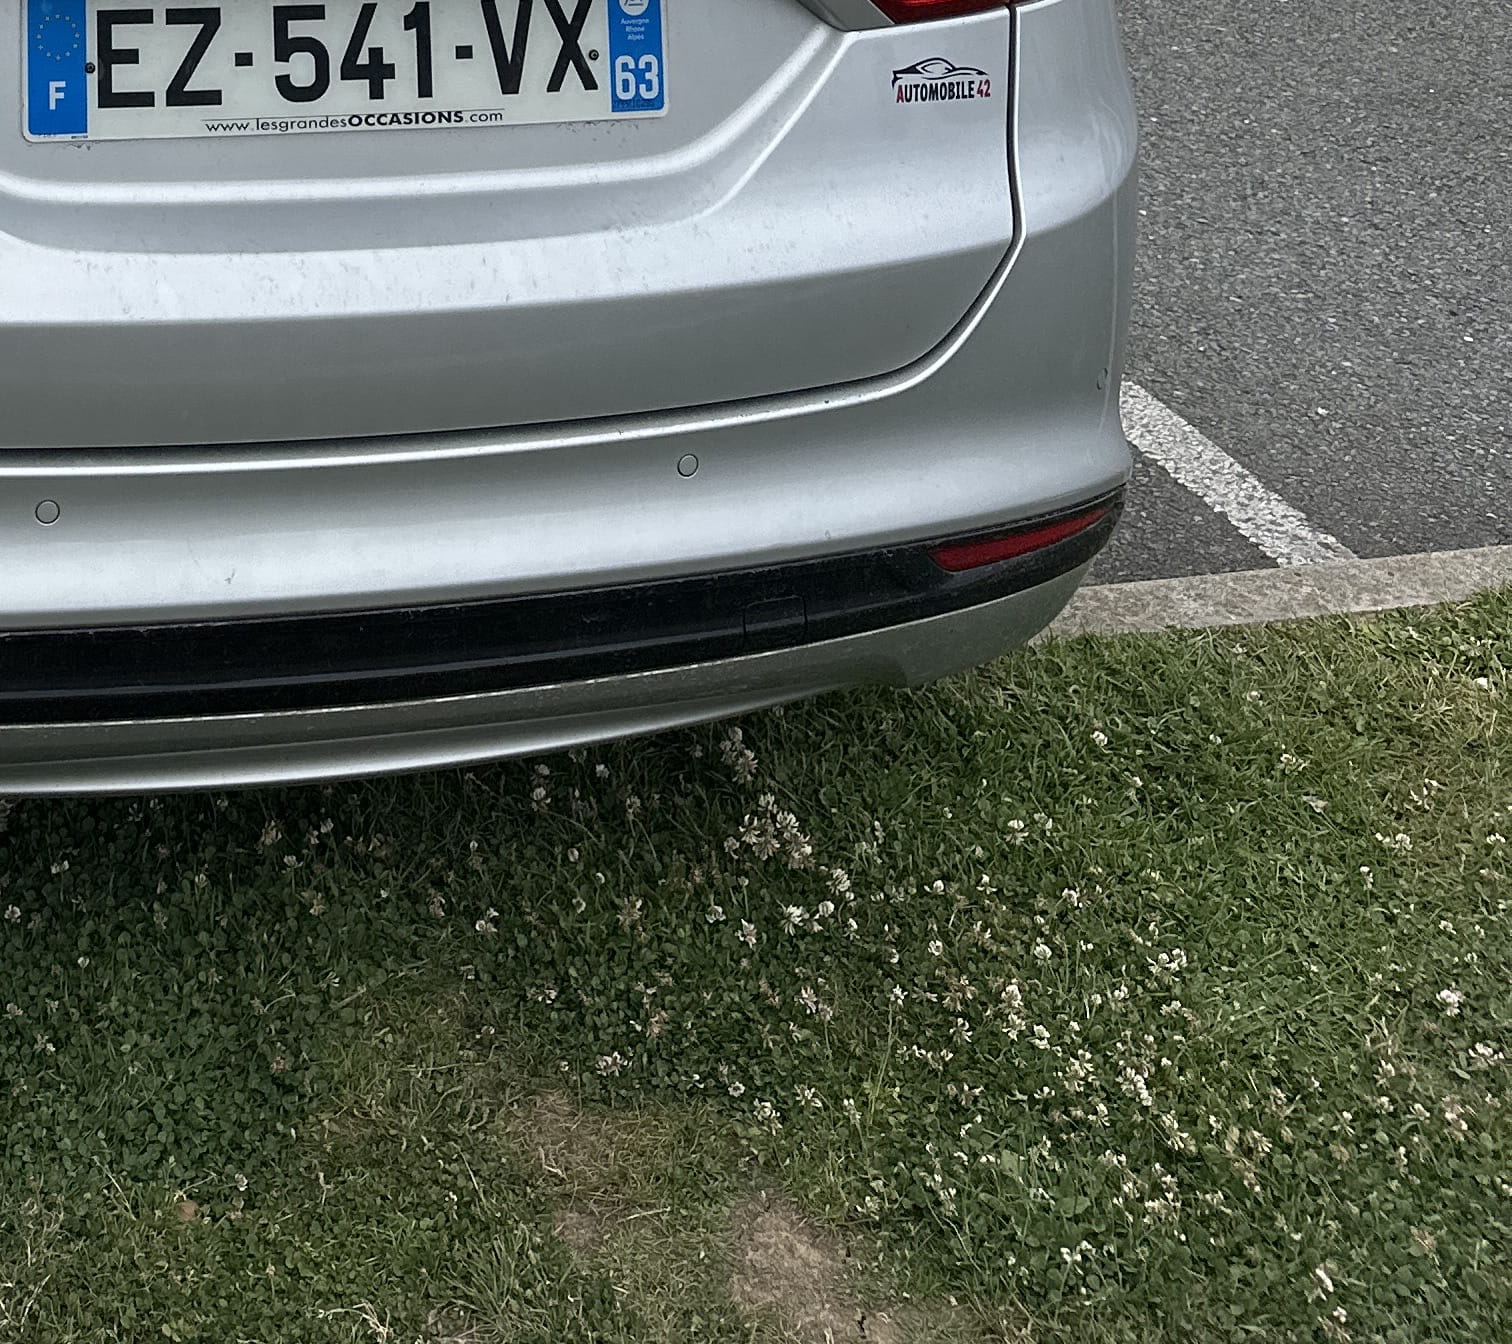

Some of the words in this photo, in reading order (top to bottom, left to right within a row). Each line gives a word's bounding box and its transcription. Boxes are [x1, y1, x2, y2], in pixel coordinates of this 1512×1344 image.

[614, 53, 660, 101] 63
[896, 80, 975, 104] AUTOMOBILE
[976, 78, 991, 98] 42
[49, 80, 66, 111] F
